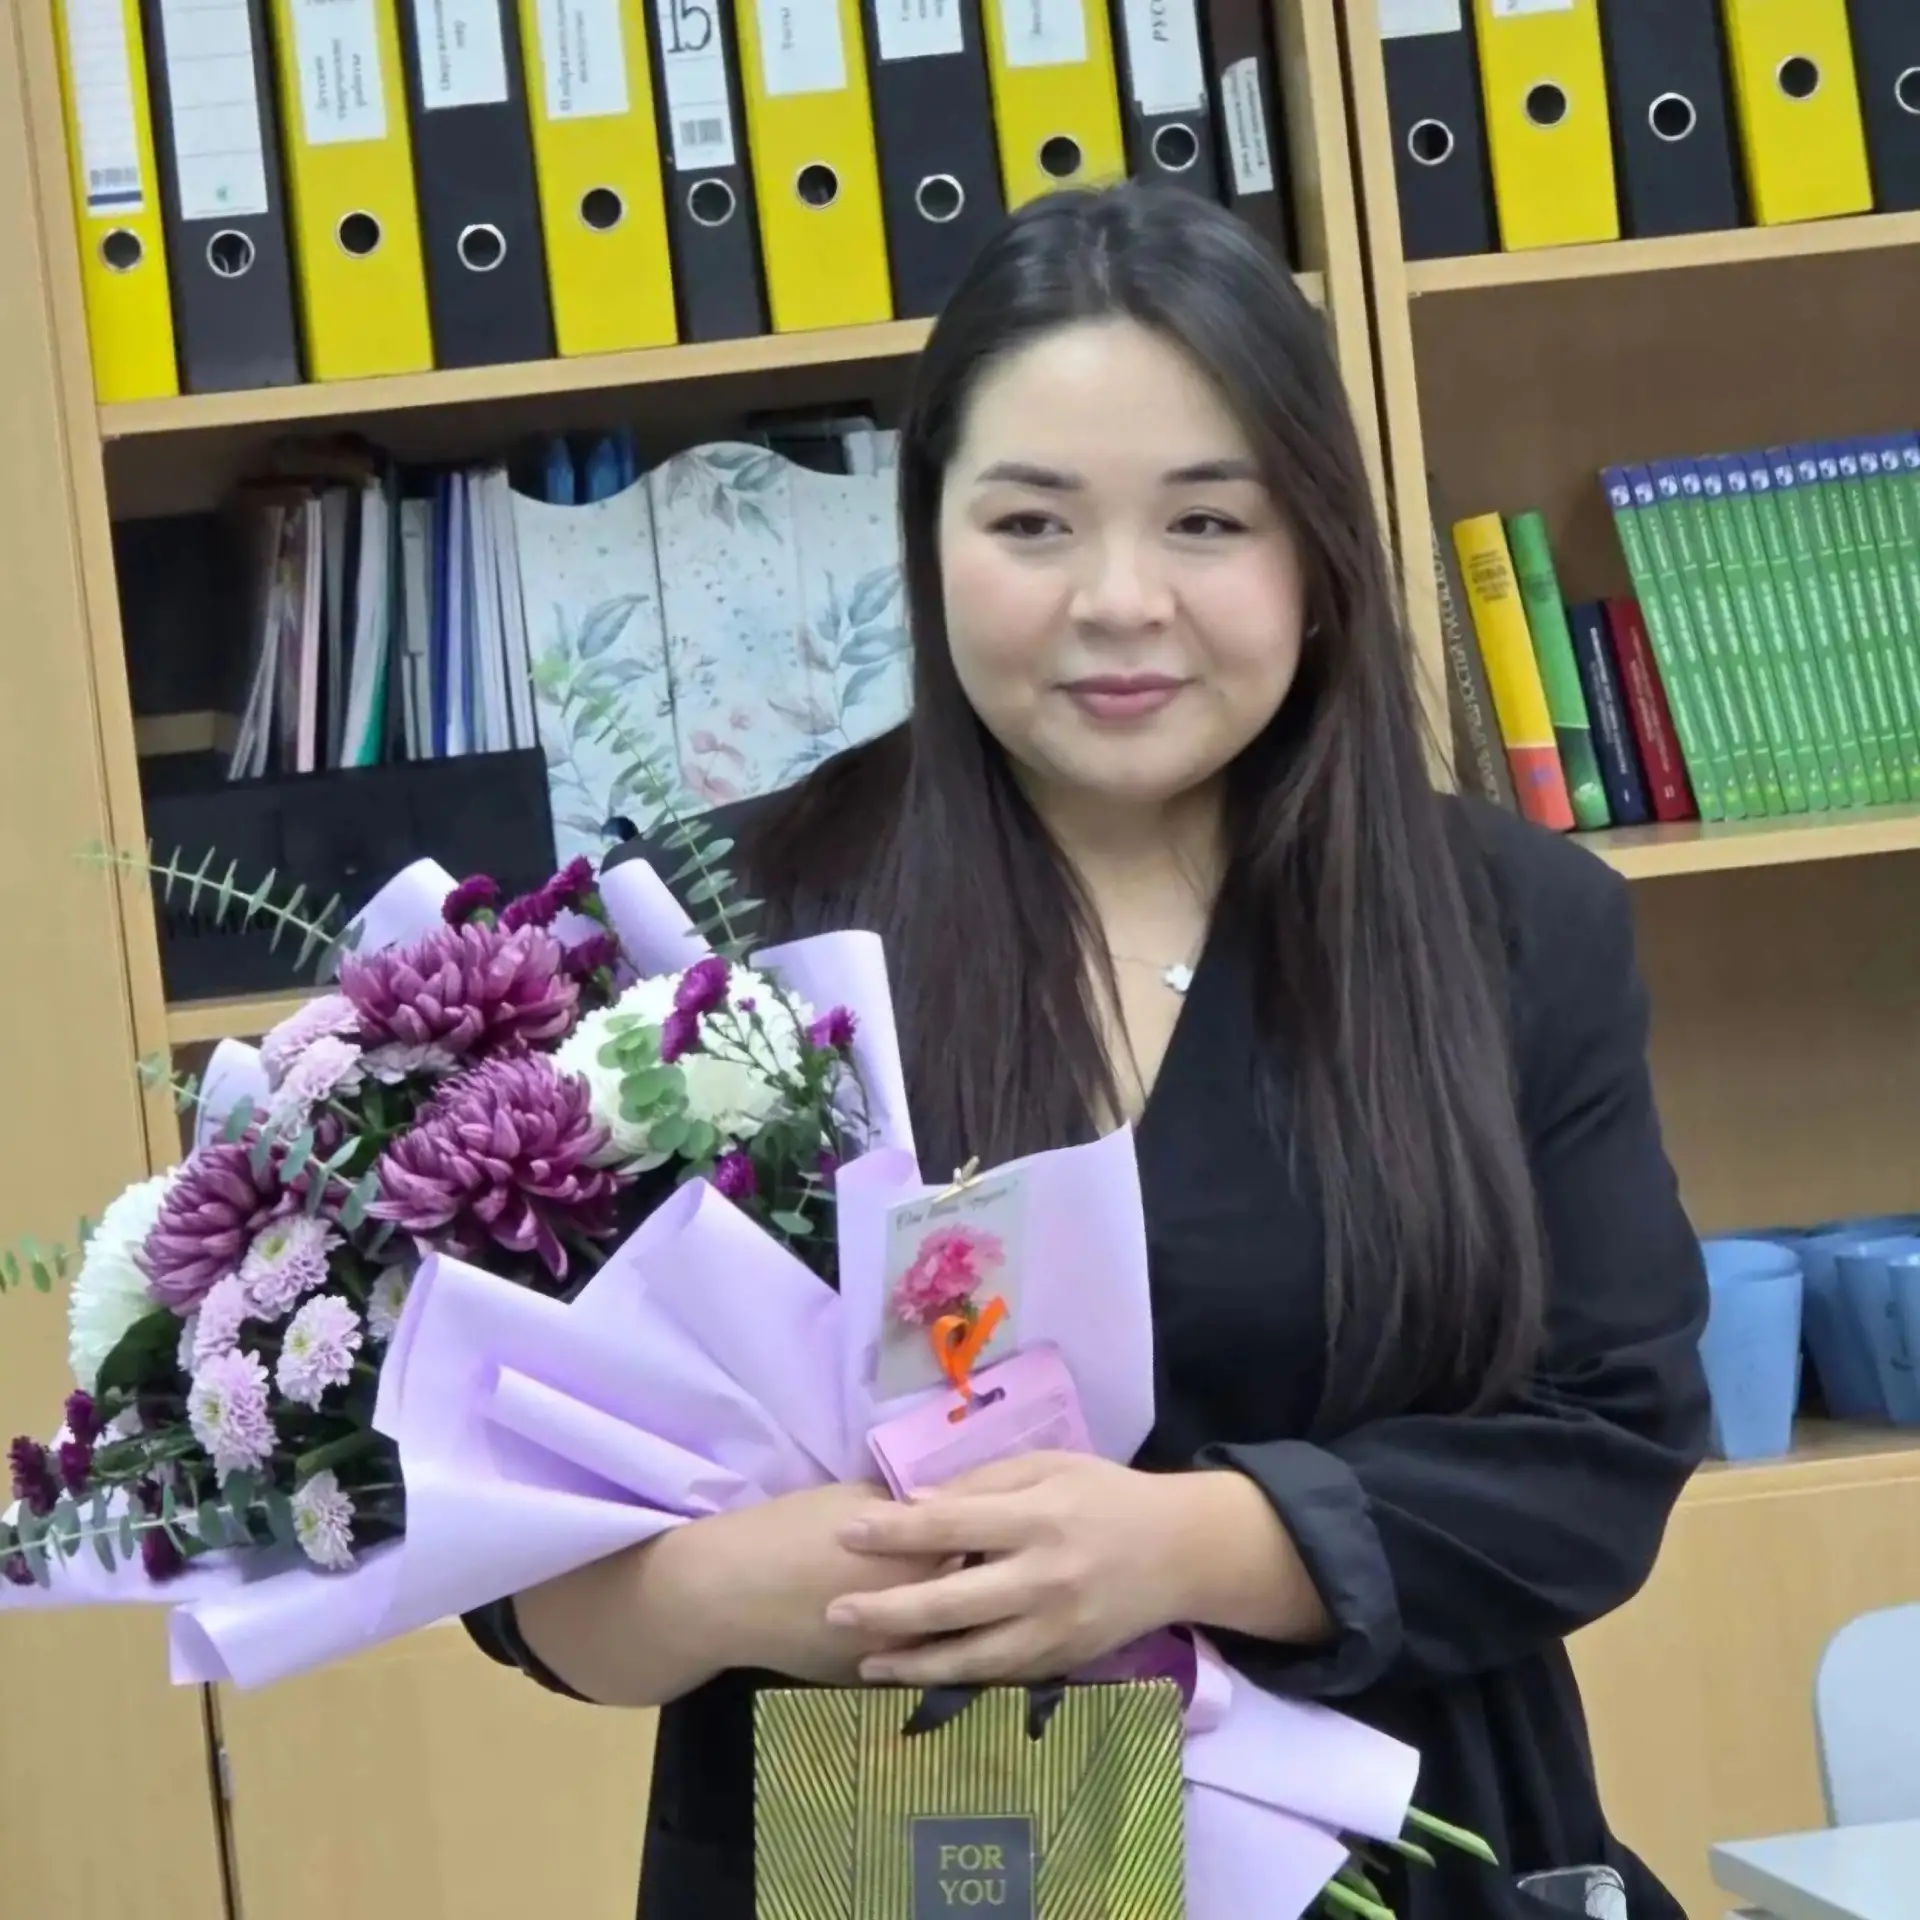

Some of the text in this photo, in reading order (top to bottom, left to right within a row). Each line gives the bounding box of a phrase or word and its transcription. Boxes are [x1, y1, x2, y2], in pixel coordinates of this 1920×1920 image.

[667, 0, 712, 54] 15
[939, 1844, 1006, 1871] FOR
[939, 1879, 1006, 1906] YOU
